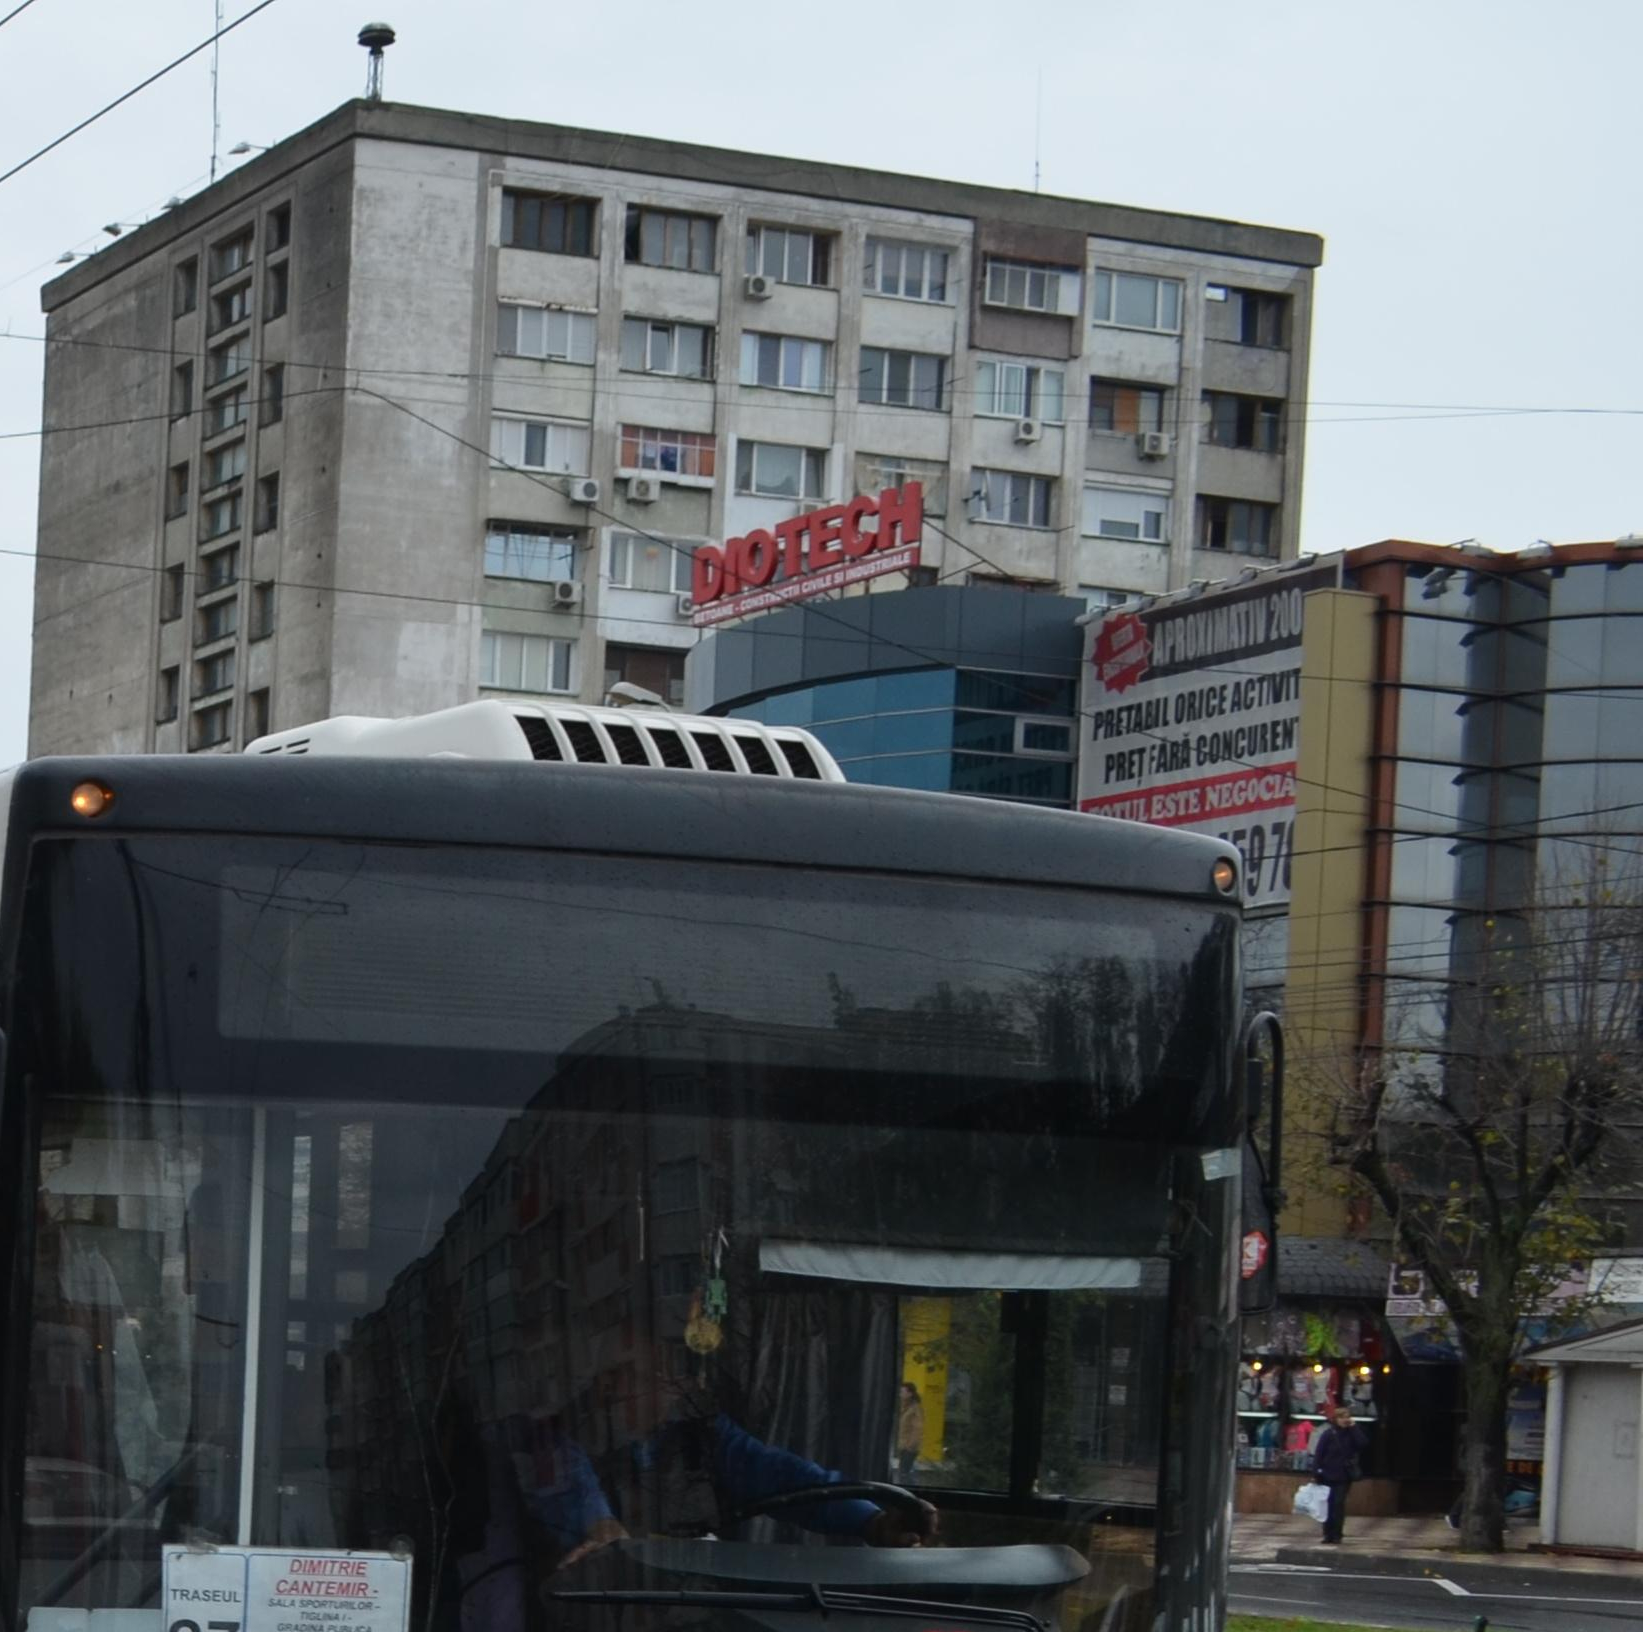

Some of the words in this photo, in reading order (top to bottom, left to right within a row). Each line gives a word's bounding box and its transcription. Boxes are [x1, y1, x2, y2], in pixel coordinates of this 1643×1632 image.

[693, 481, 923, 605] DIOTECH
[1152, 597, 1266, 667] APROXIMATIV
[1093, 696, 1169, 742] PRETABIL
[1174, 684, 1227, 725] ORICE
[1151, 788, 1200, 820] ESTE
[289, 1558, 368, 1576] DIMITRIE
[170, 1588, 242, 1603] TRASEUL
[275, 1579, 369, 1597] CANTEMIR
[267, 1598, 297, 1609] SALA
[298, 1599, 373, 1611] SPORTURILOR
[300, 1611, 340, 1622] TIGLINA
